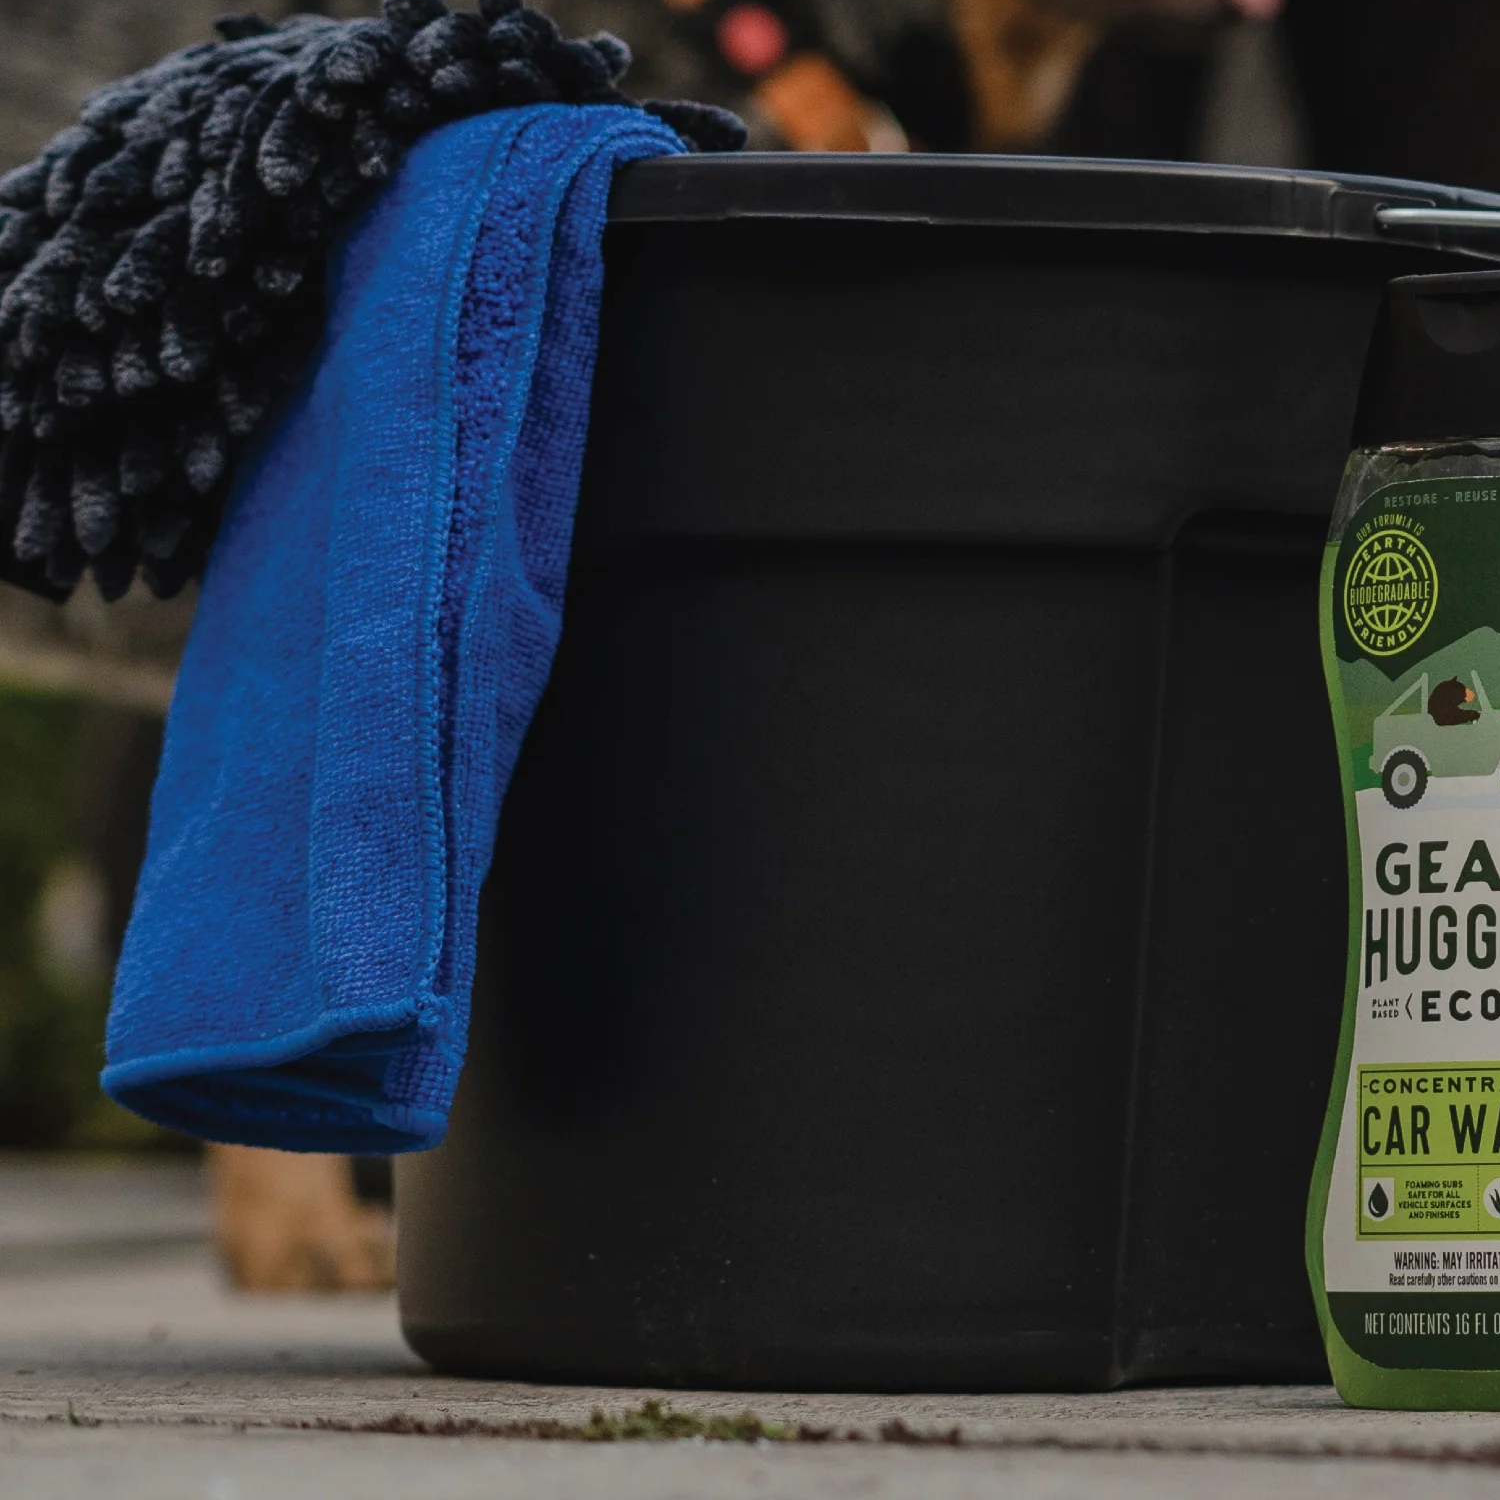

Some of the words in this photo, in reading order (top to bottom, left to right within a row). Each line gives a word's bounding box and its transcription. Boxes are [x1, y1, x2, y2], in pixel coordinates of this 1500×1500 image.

[1384, 493, 1437, 508] RESTORE
[1455, 489, 1497, 502] REUSE
[1356, 522, 1371, 542] OUR
[1413, 522, 1425, 537] IS
[1362, 536, 1417, 562] EARTH
[1350, 580, 1430, 606] BIODEGRADABLE
[1354, 611, 1423, 647] FRIENDLY
[1372, 998, 1399, 1008] PLANT
[1372, 1010, 1399, 1019] BASED
[1363, 1105, 1431, 1156] CAR
[1405, 1180, 1440, 1189] FOAMING
[1408, 1191, 1427, 1199] SAFE
[1428, 1190, 1444, 1199] FOR
[1445, 1190, 1461, 1199] ALL
[1398, 1200, 1429, 1209] VEHICLE
[1430, 1200, 1472, 1209] SURFACES
[1408, 1211, 1425, 1219] AND
[1425, 1210, 1461, 1219] FINISHES
[1394, 1252, 1440, 1270] WARNING:
[1442, 1252, 1463, 1270] MAY
[1389, 1273, 1405, 1286] Read
[1406, 1272, 1435, 1288] carefully
[1437, 1273, 1456, 1286] other
[1457, 1272, 1488, 1286] cautions
[1489, 1275, 1499, 1285] on
[1364, 1312, 1386, 1335] NET
[1389, 1312, 1450, 1335] CONTENTS
[1455, 1312, 1470, 1335] 16
[1475, 1312, 1489, 1335] FL
